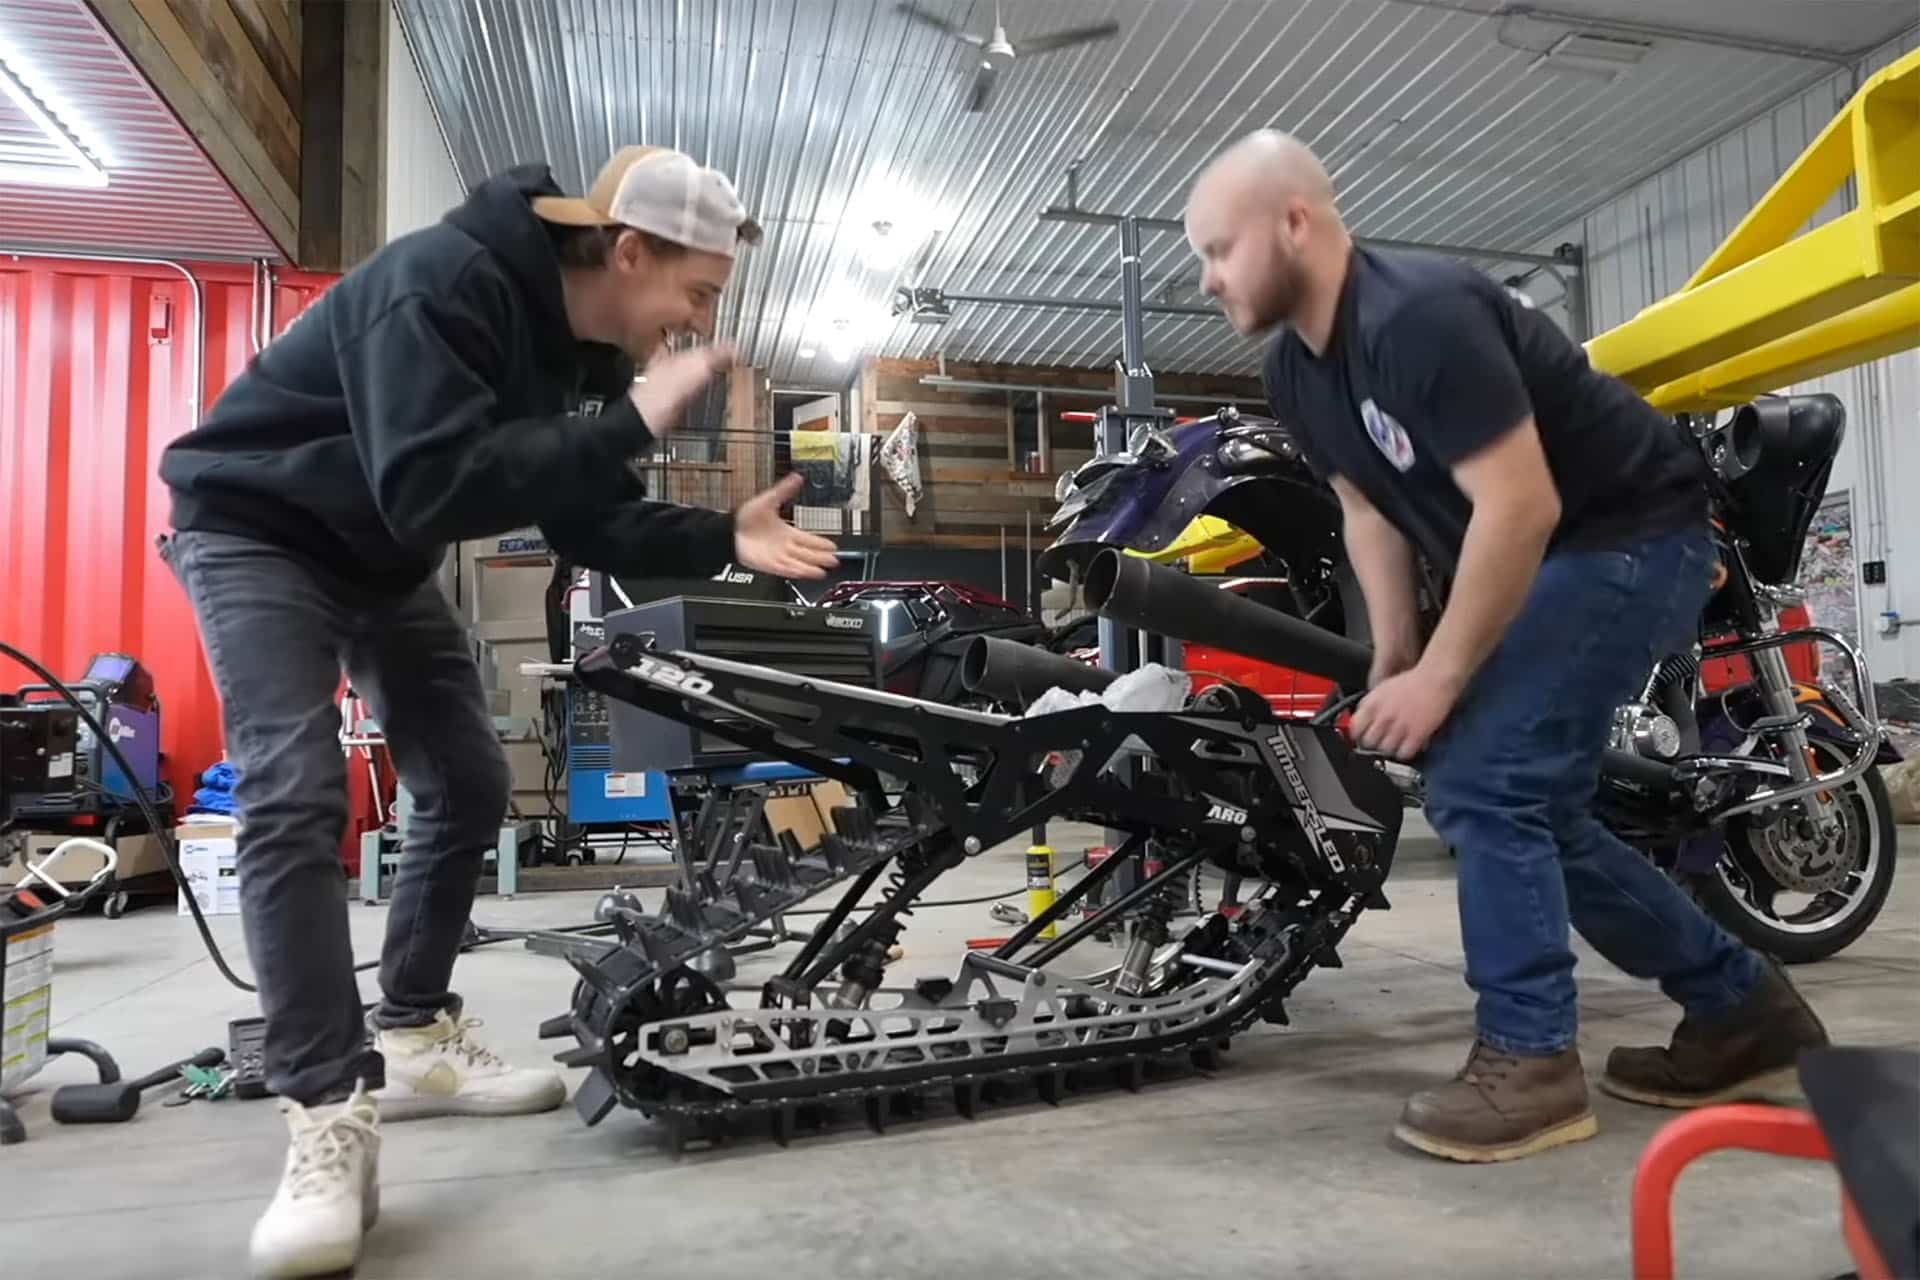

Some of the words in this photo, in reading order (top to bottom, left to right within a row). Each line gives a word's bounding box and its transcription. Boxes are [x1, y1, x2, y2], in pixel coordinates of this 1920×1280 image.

[629, 657, 714, 696] 120
[1206, 804, 1248, 825] ARO
[1267, 724, 1346, 874] TIMBERSLED
